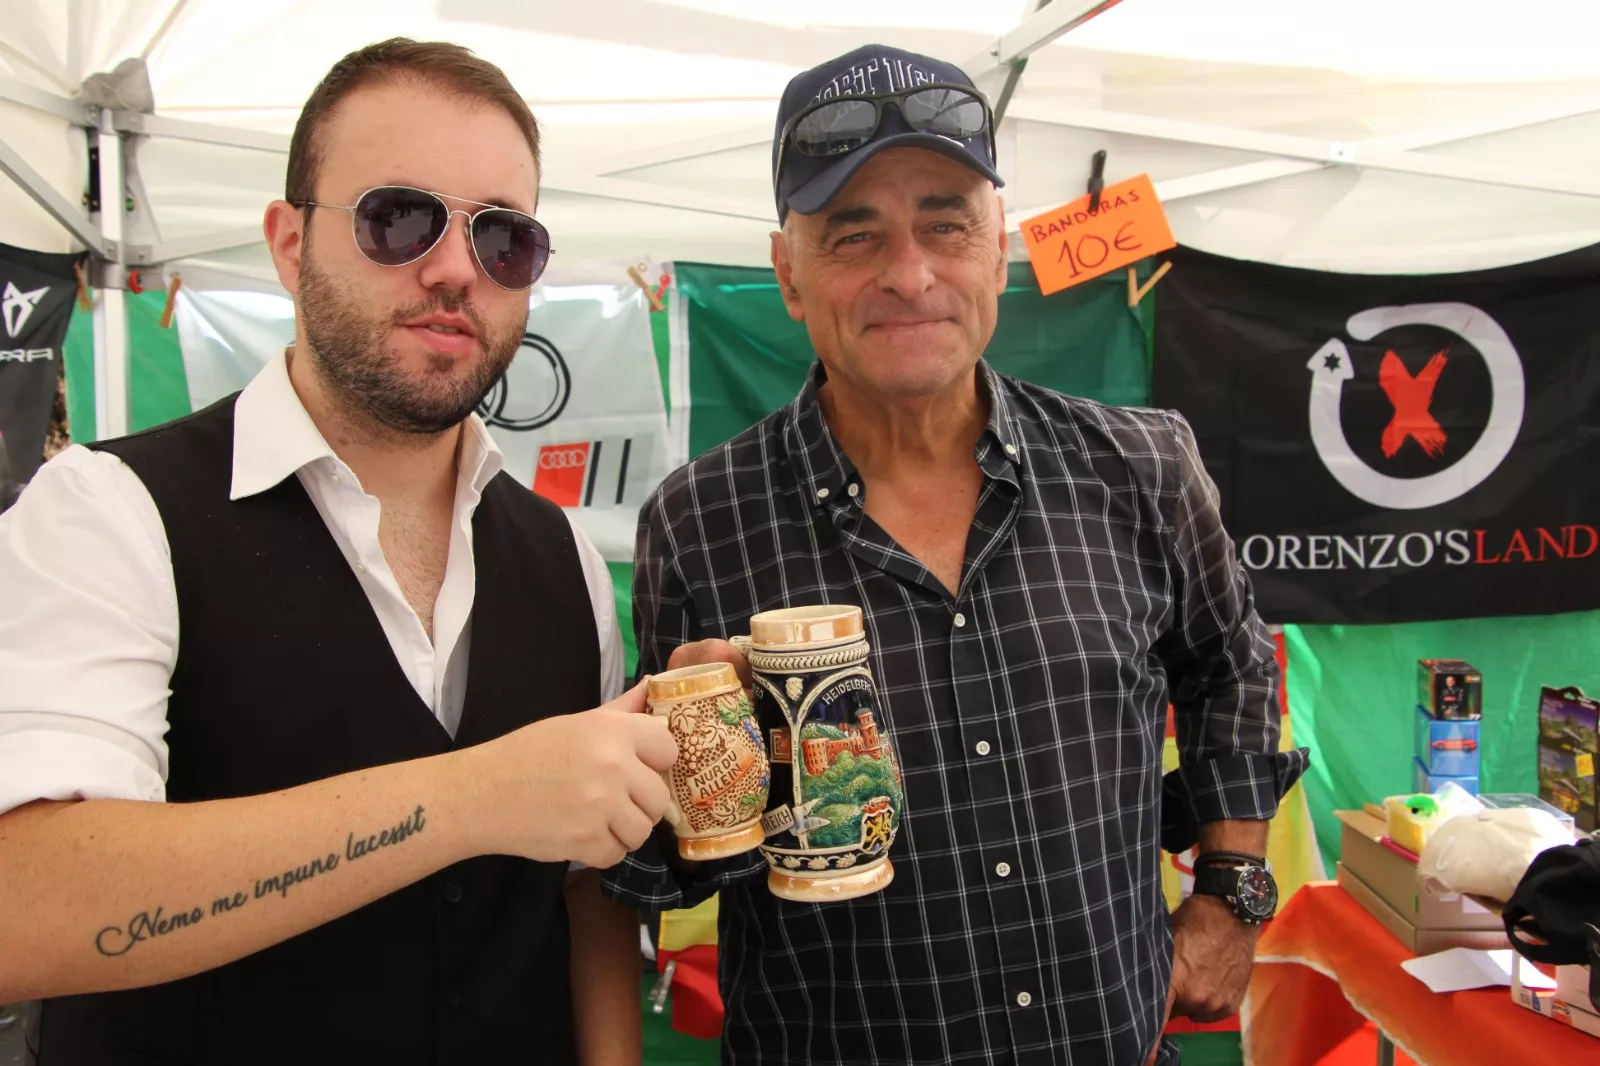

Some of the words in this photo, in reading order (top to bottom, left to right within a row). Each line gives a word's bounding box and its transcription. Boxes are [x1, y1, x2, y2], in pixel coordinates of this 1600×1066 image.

[693, 766, 724, 788] NUR
[722, 750, 738, 770] DU
[700, 763, 743, 800] ALLEIN
[95, 905, 205, 957] Nemo
[211, 890, 250, 917] me
[254, 852, 341, 898] impune
[345, 804, 426, 862] lacessit
